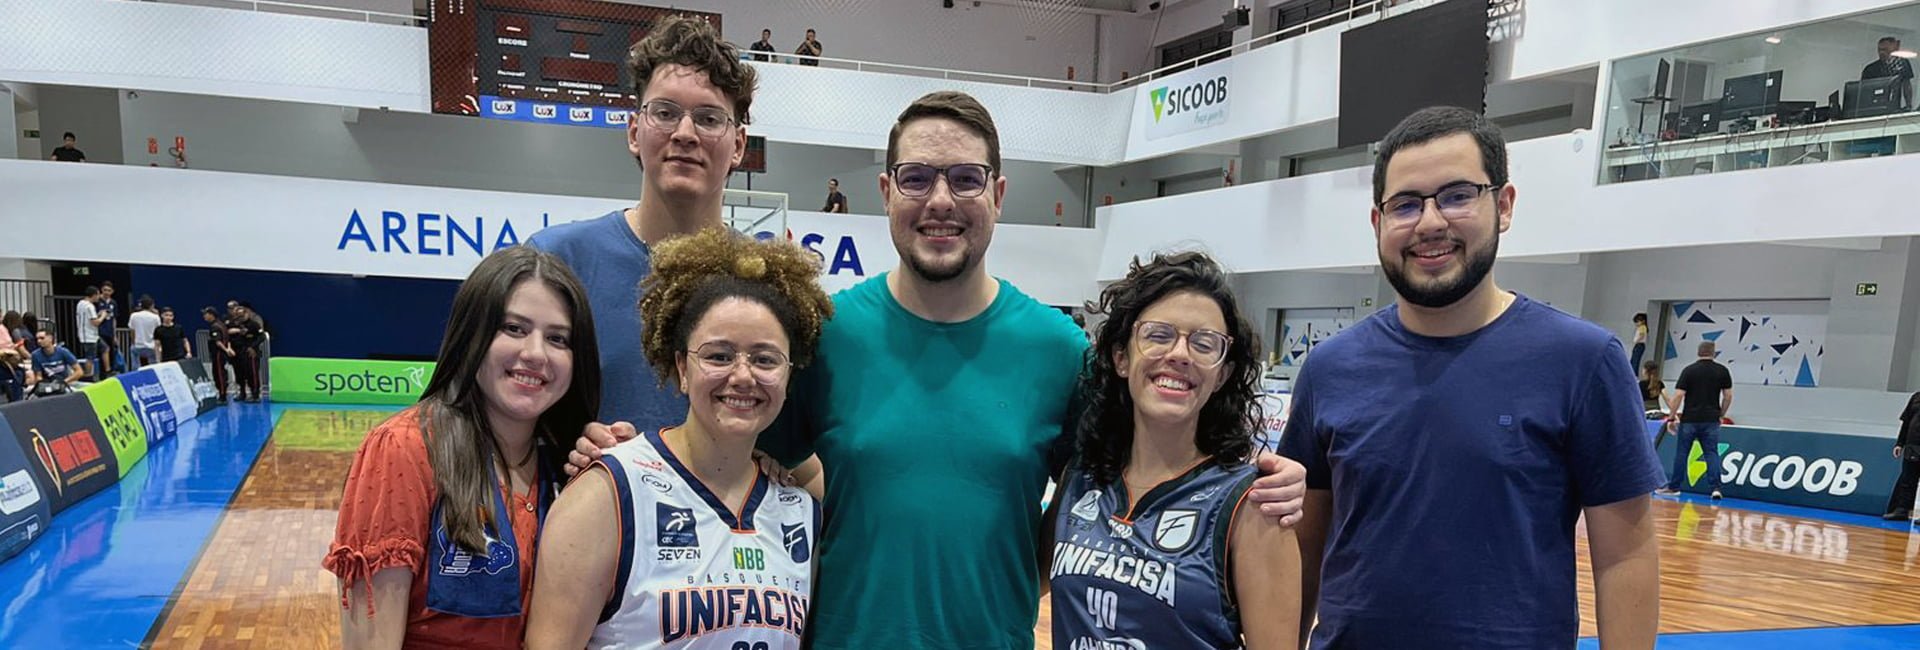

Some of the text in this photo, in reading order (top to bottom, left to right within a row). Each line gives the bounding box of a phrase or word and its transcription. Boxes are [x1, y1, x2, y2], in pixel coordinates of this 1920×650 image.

[1168, 76, 1227, 115] SICOOB
[337, 208, 520, 258] ARENA
[314, 370, 410, 396] spoten
[1720, 451, 1863, 496] SICOOB
[657, 549, 701, 560] SEVEN
[733, 547, 765, 571] NBB
[687, 573, 801, 591] BASQUETE
[1050, 542, 1176, 607] UNIFACISA
[1086, 587, 1118, 631] 40
